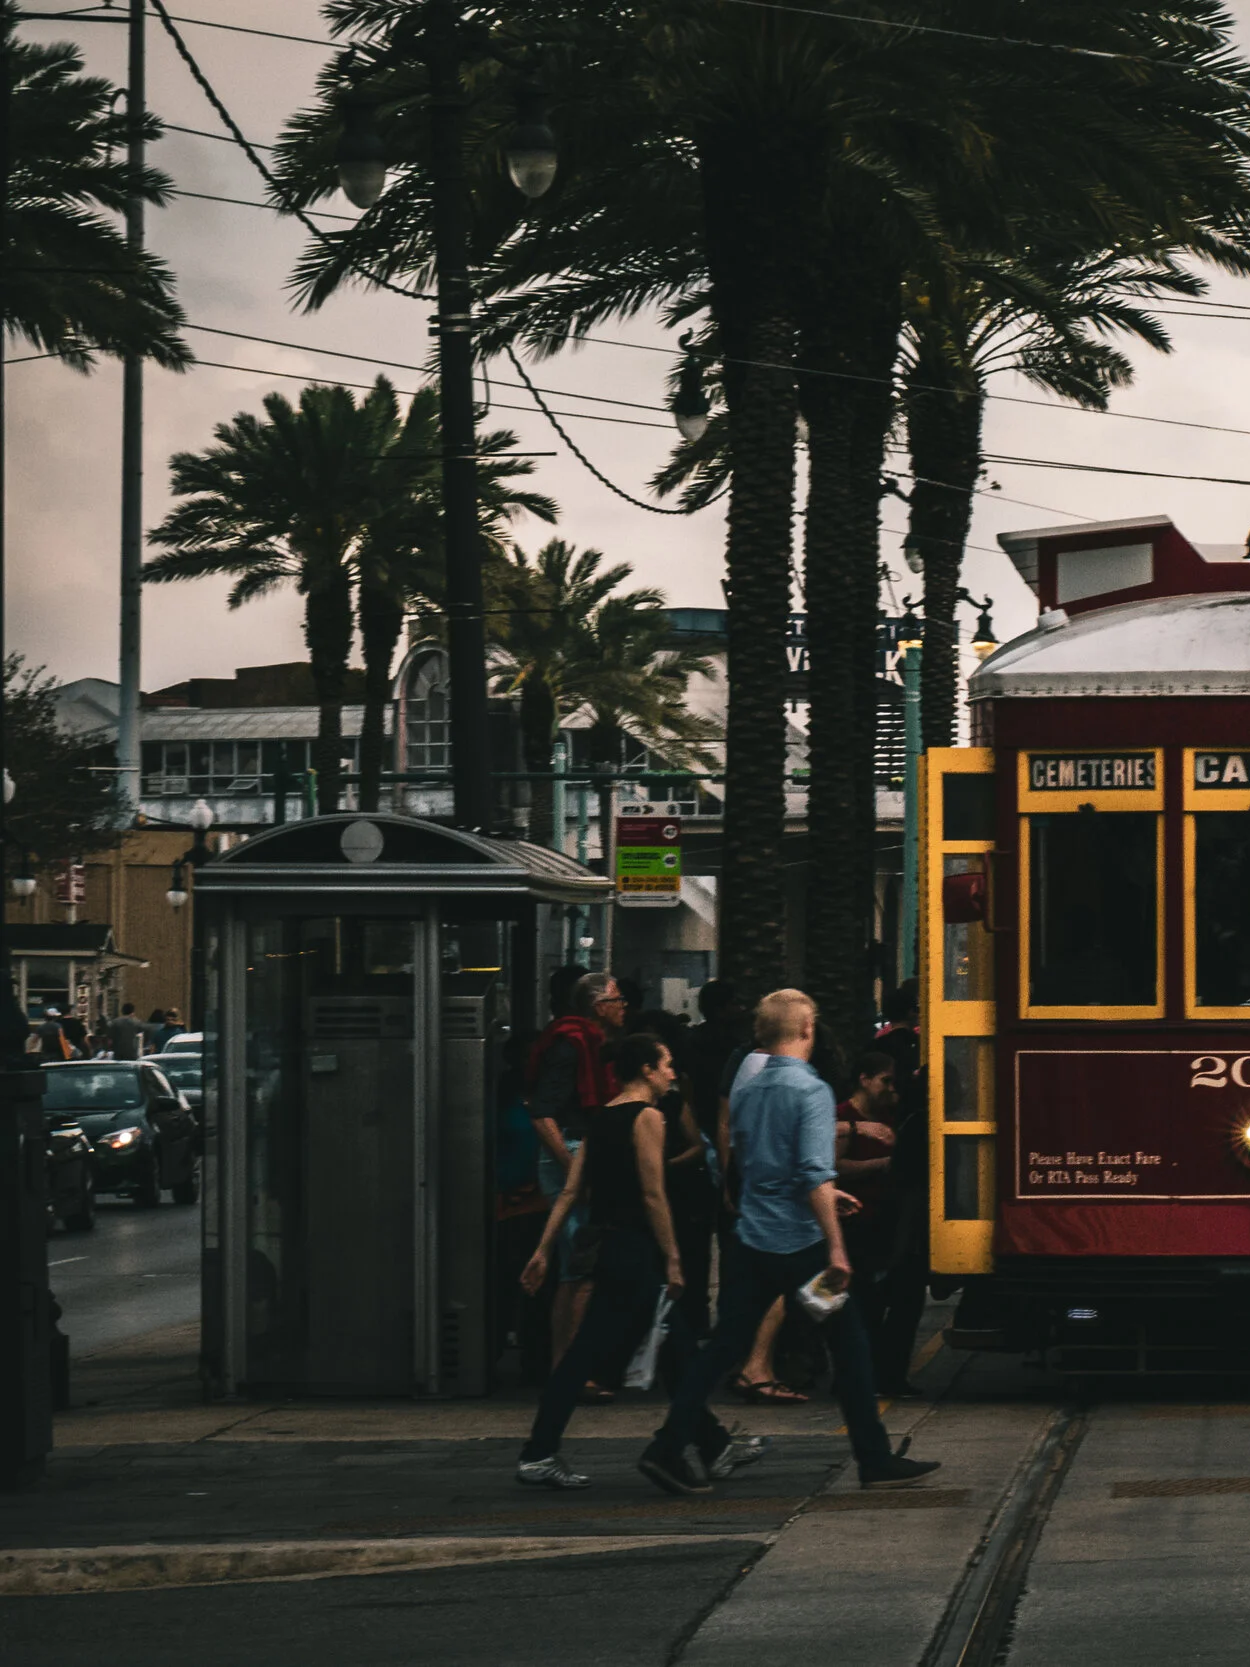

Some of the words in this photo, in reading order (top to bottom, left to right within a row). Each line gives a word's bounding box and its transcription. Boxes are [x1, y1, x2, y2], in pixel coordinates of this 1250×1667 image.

[1032, 759, 1155, 787] CEMETERIES
[1028, 1152, 1063, 1165] Please
[1066, 1152, 1094, 1165] Have
[1097, 1152, 1131, 1165] Exact
[1134, 1152, 1162, 1165] Fare
[1028, 1171, 1044, 1184] Or
[1047, 1171, 1071, 1184] RTA
[1074, 1171, 1100, 1184] Pass
[1103, 1171, 1139, 1186] Ready
